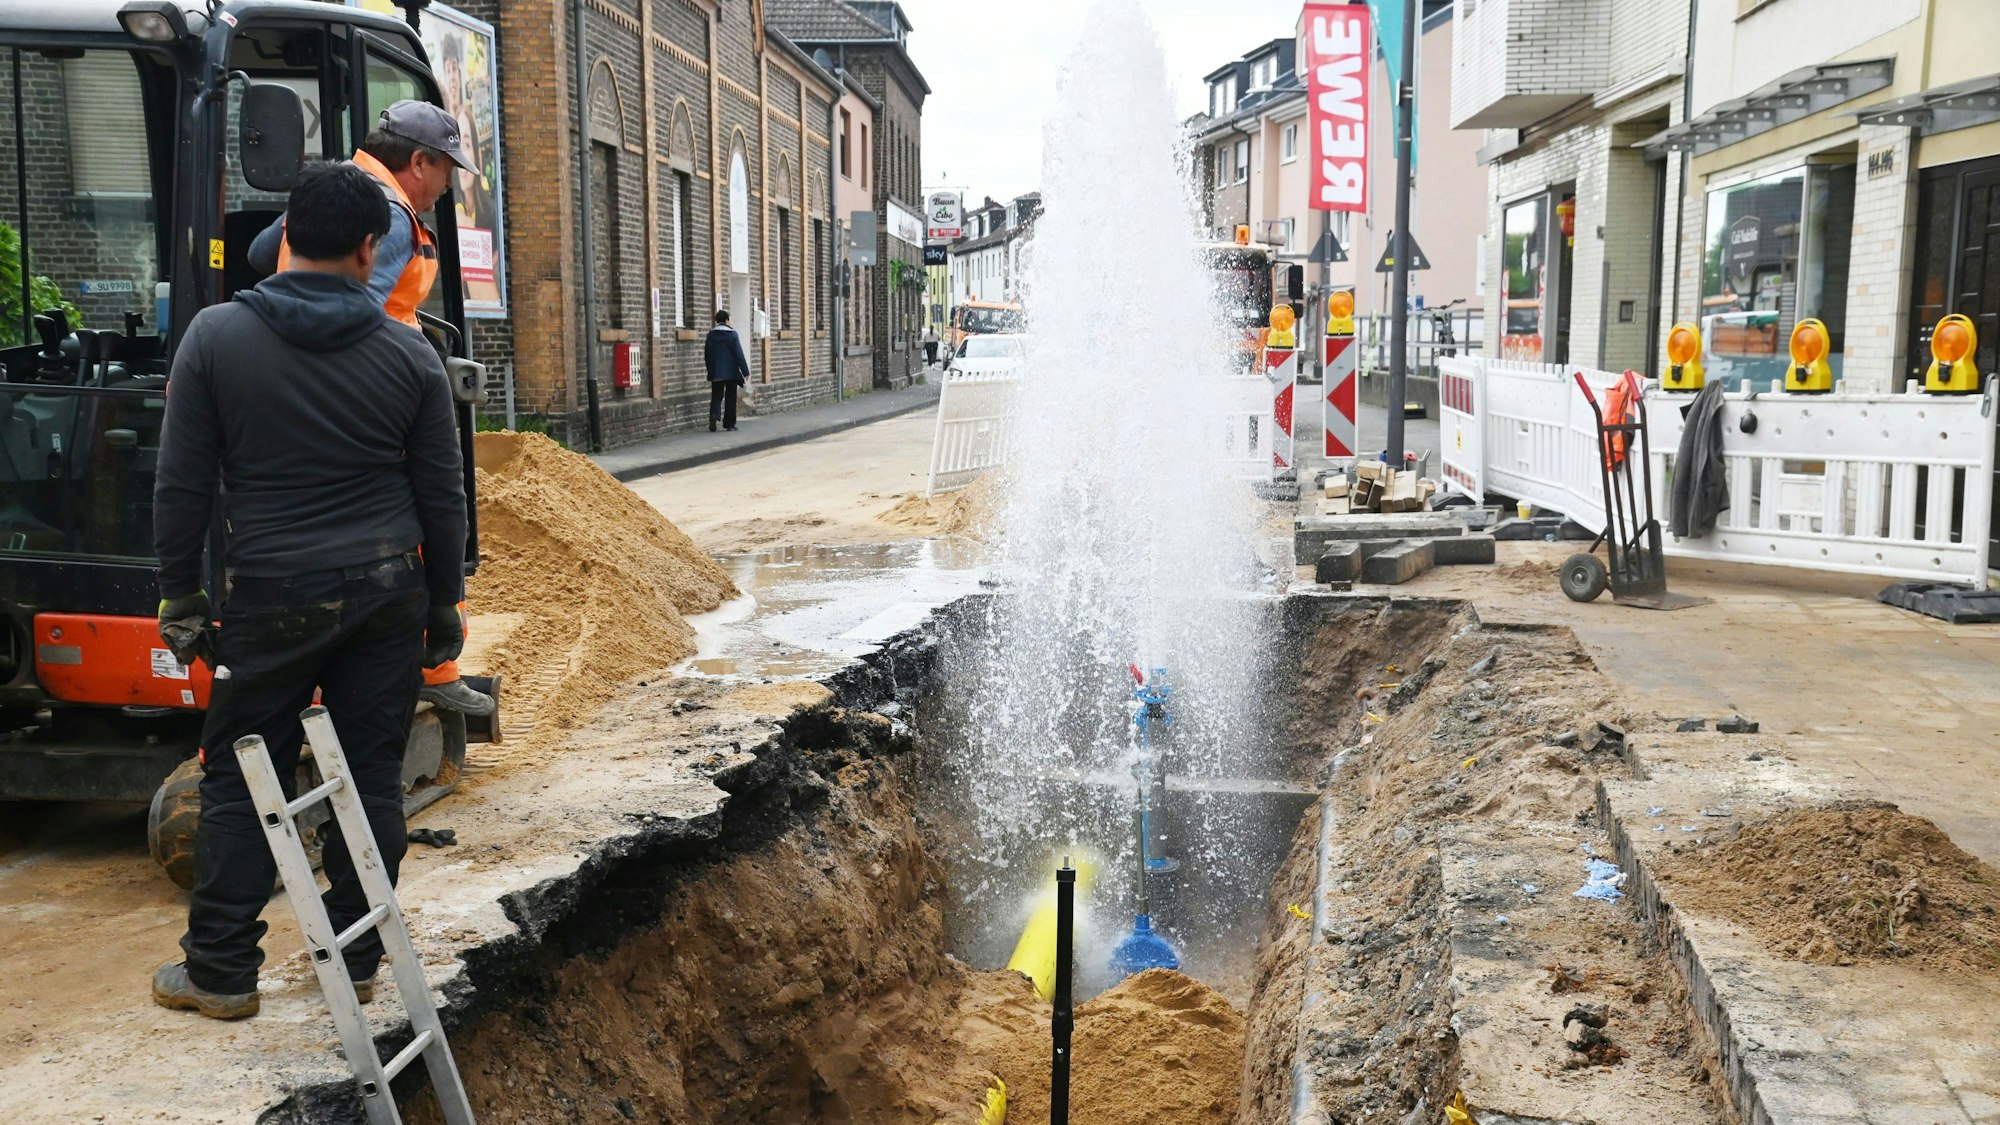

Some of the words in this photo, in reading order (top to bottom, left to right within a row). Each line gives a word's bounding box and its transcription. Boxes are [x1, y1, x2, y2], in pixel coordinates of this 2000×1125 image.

[932, 197, 955, 206] Buon
[935, 210, 953, 219] Cibo
[926, 249, 945, 260] sky
